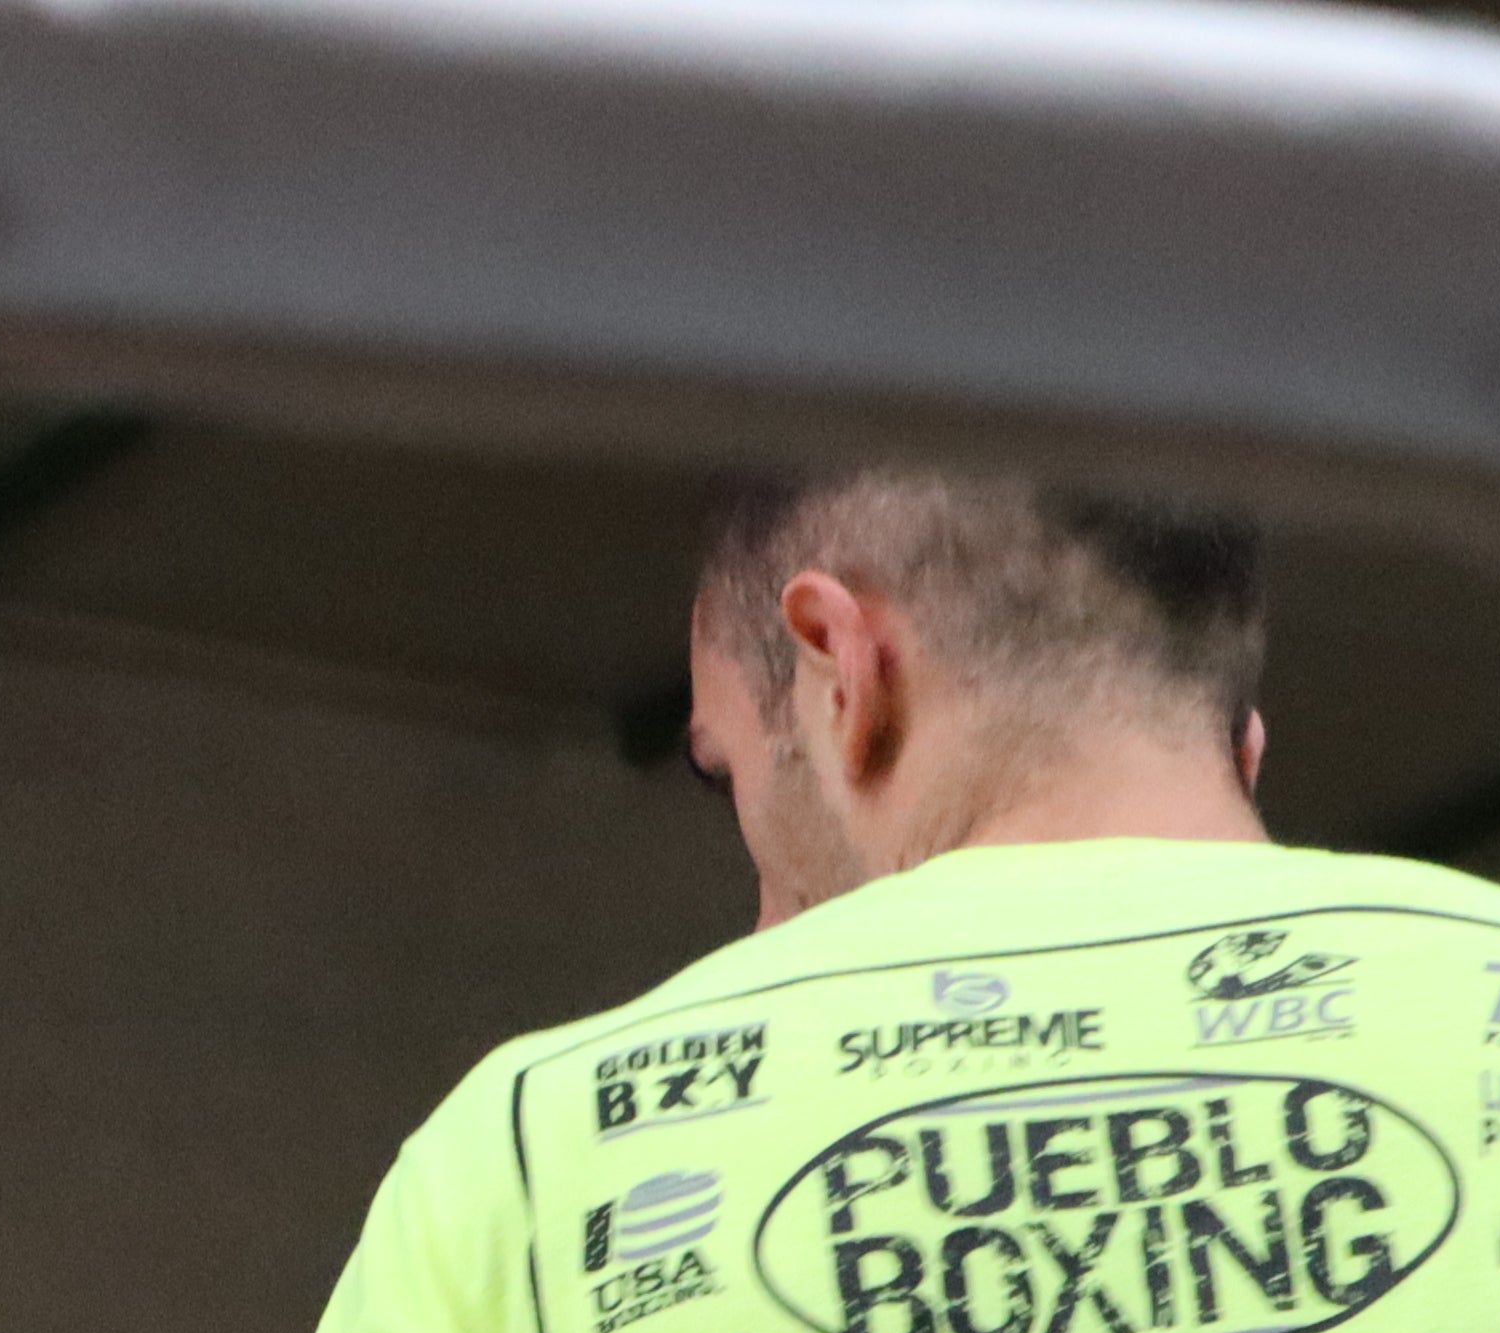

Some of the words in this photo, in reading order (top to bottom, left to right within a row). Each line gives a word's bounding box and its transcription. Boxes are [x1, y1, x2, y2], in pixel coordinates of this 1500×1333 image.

[838, 1007, 1105, 1076] SUPREME
[1196, 988, 1356, 1043] WBC
[596, 1022, 768, 1082] GOLDEN
[822, 1078, 1373, 1236] PUEBLO
[592, 1248, 714, 1314] USA
